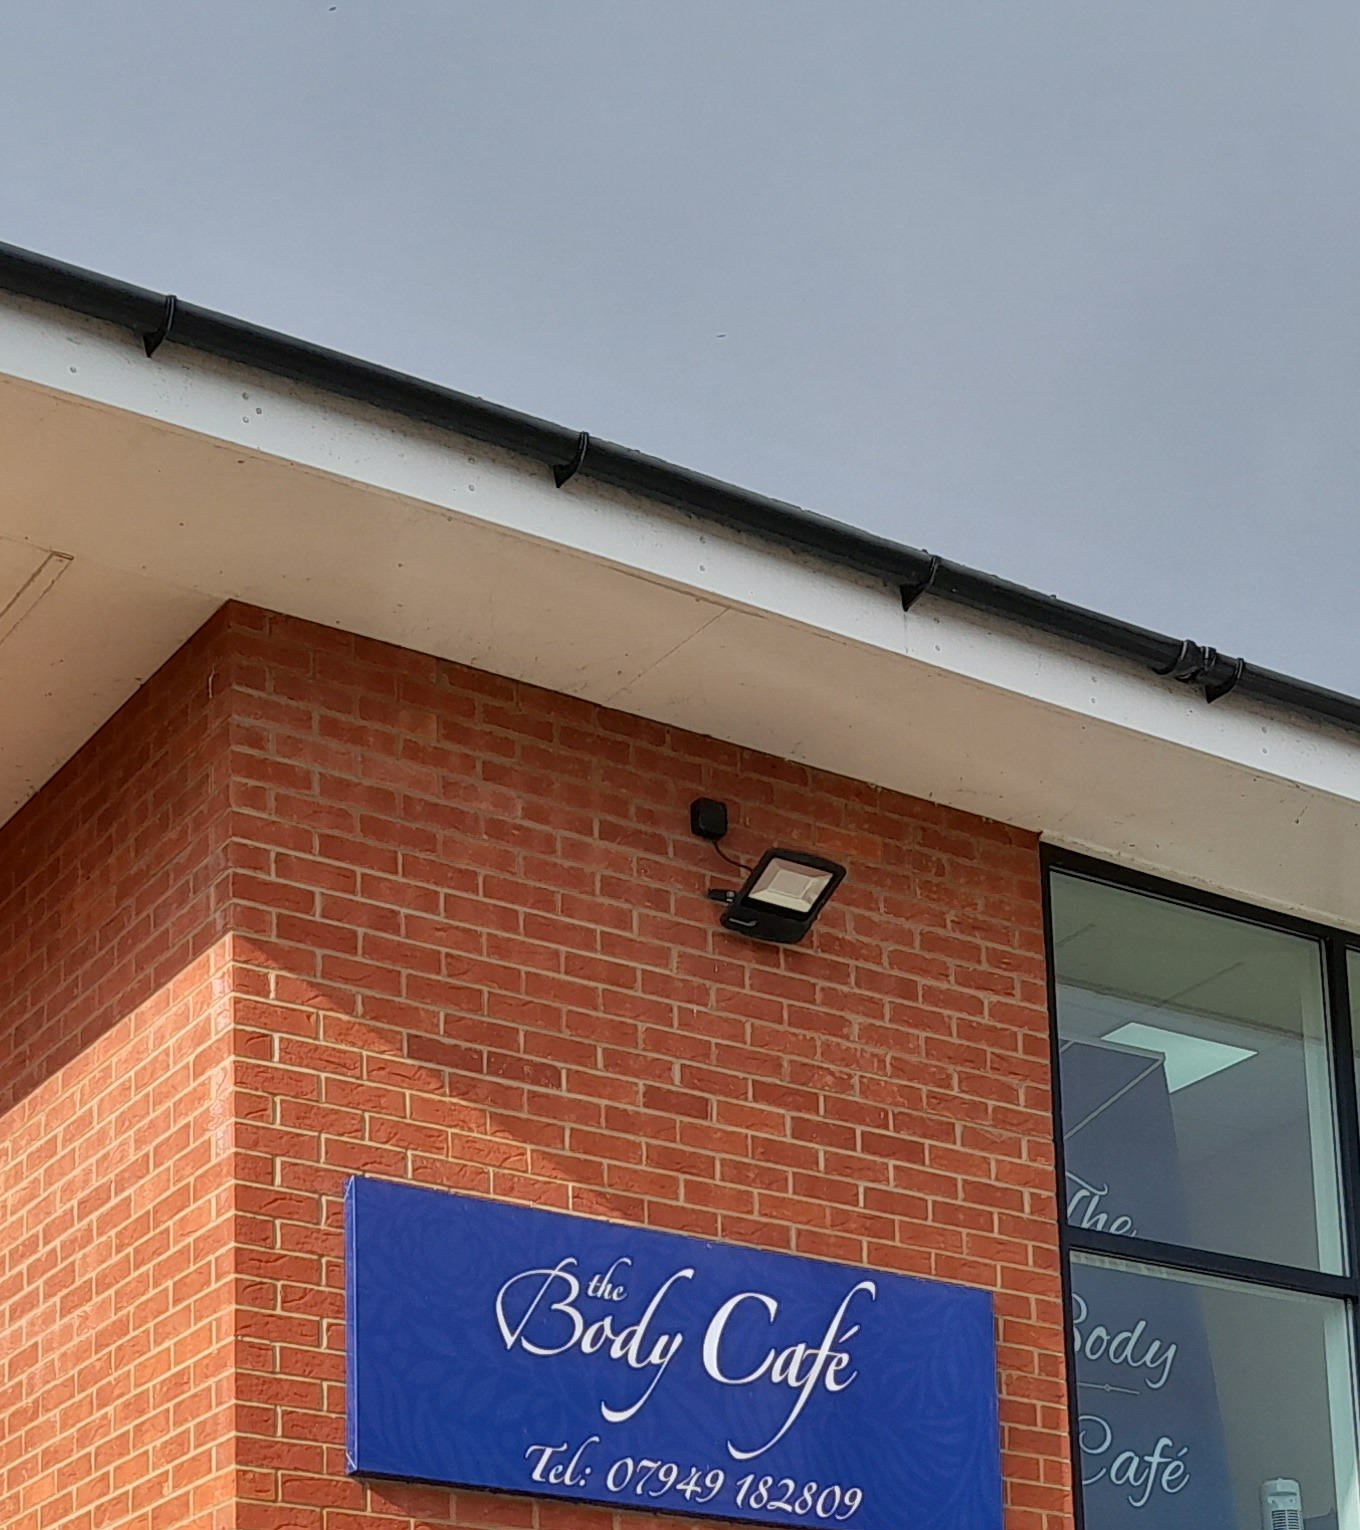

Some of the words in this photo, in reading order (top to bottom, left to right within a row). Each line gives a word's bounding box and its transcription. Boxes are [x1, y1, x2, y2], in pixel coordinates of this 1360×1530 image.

[588, 1257, 630, 1300] the
[496, 1257, 695, 1422] Body
[703, 1280, 876, 1459] Café
[525, 1435, 600, 1487] Tel:
[606, 1456, 724, 1503] 07949
[735, 1472, 863, 1521] 182809
